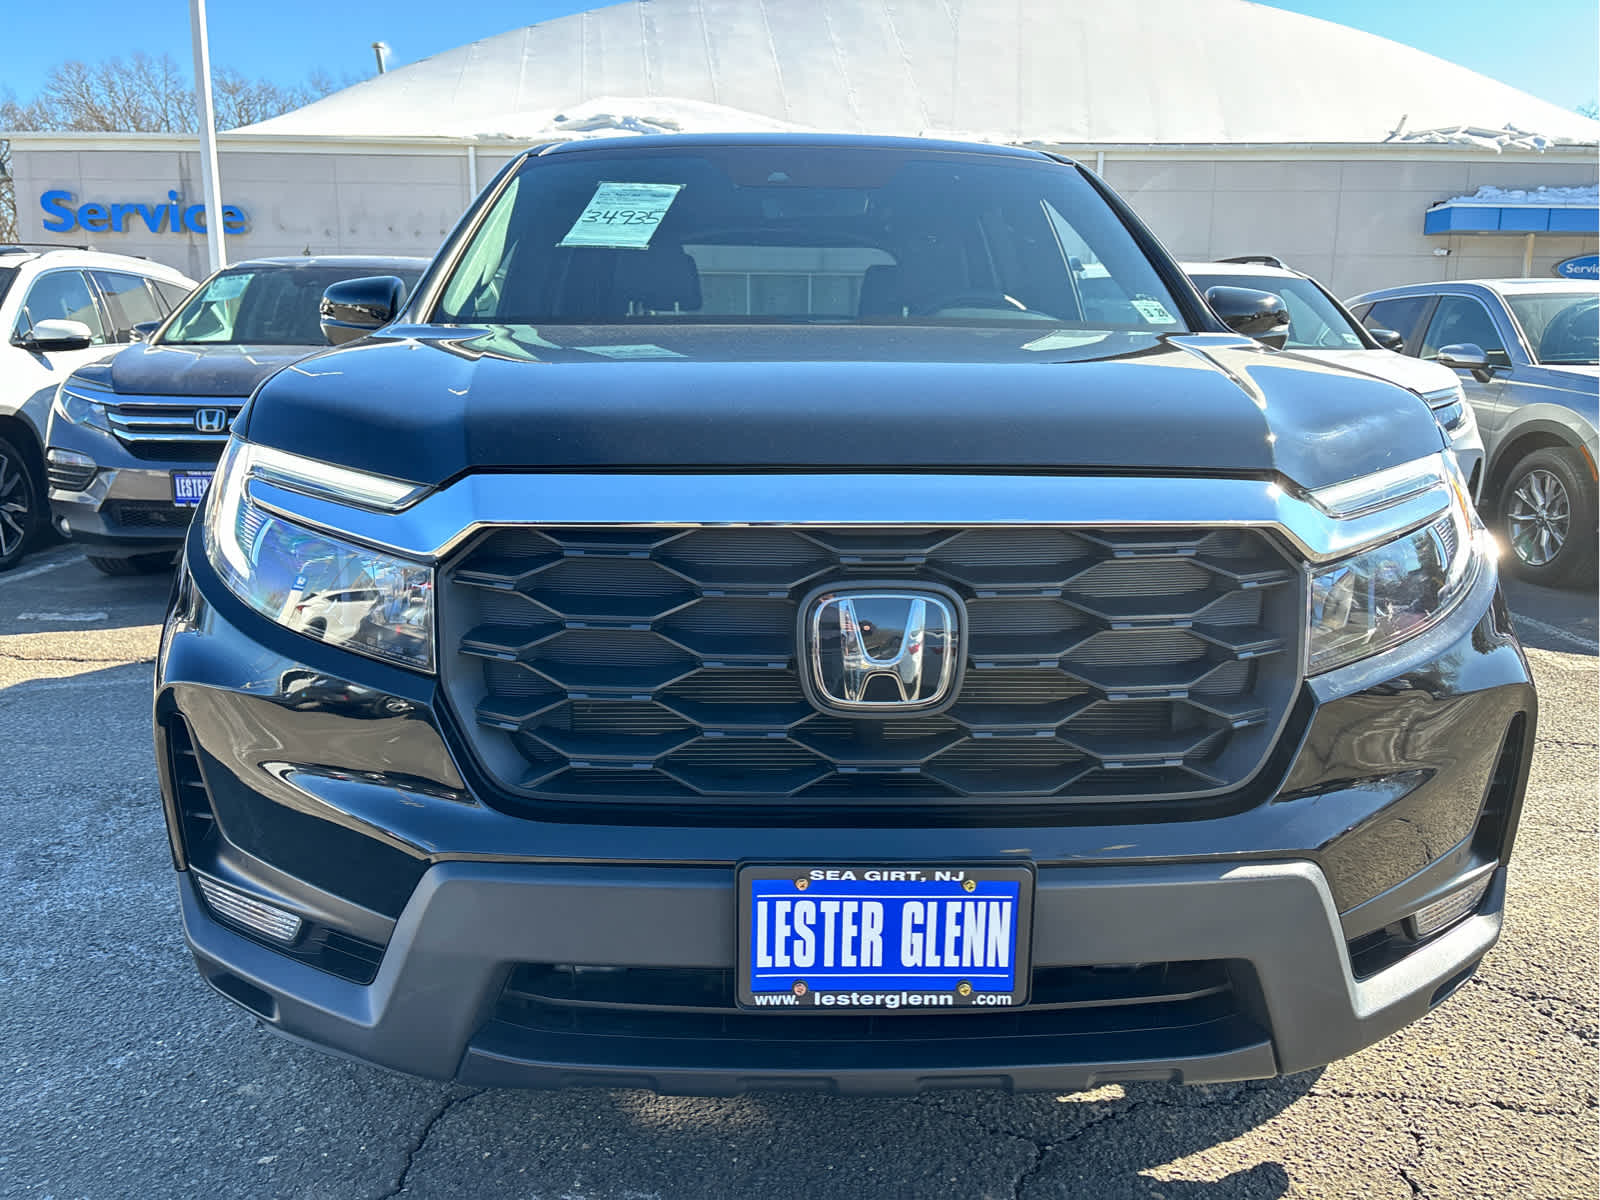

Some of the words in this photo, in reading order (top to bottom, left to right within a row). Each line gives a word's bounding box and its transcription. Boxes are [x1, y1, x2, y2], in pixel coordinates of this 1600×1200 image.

[40, 189, 247, 235] Service
[582, 210, 664, 225] 34935
[809, 870, 857, 881] SEA
[864, 870, 927, 883] GIRT,
[935, 871, 965, 882] NJ
[756, 900, 885, 969] LESTER
[900, 900, 1013, 968] GLENN
[755, 994, 800, 1006] www.
[814, 991, 953, 1009] lesterglenn
[972, 993, 1012, 1006] .com
